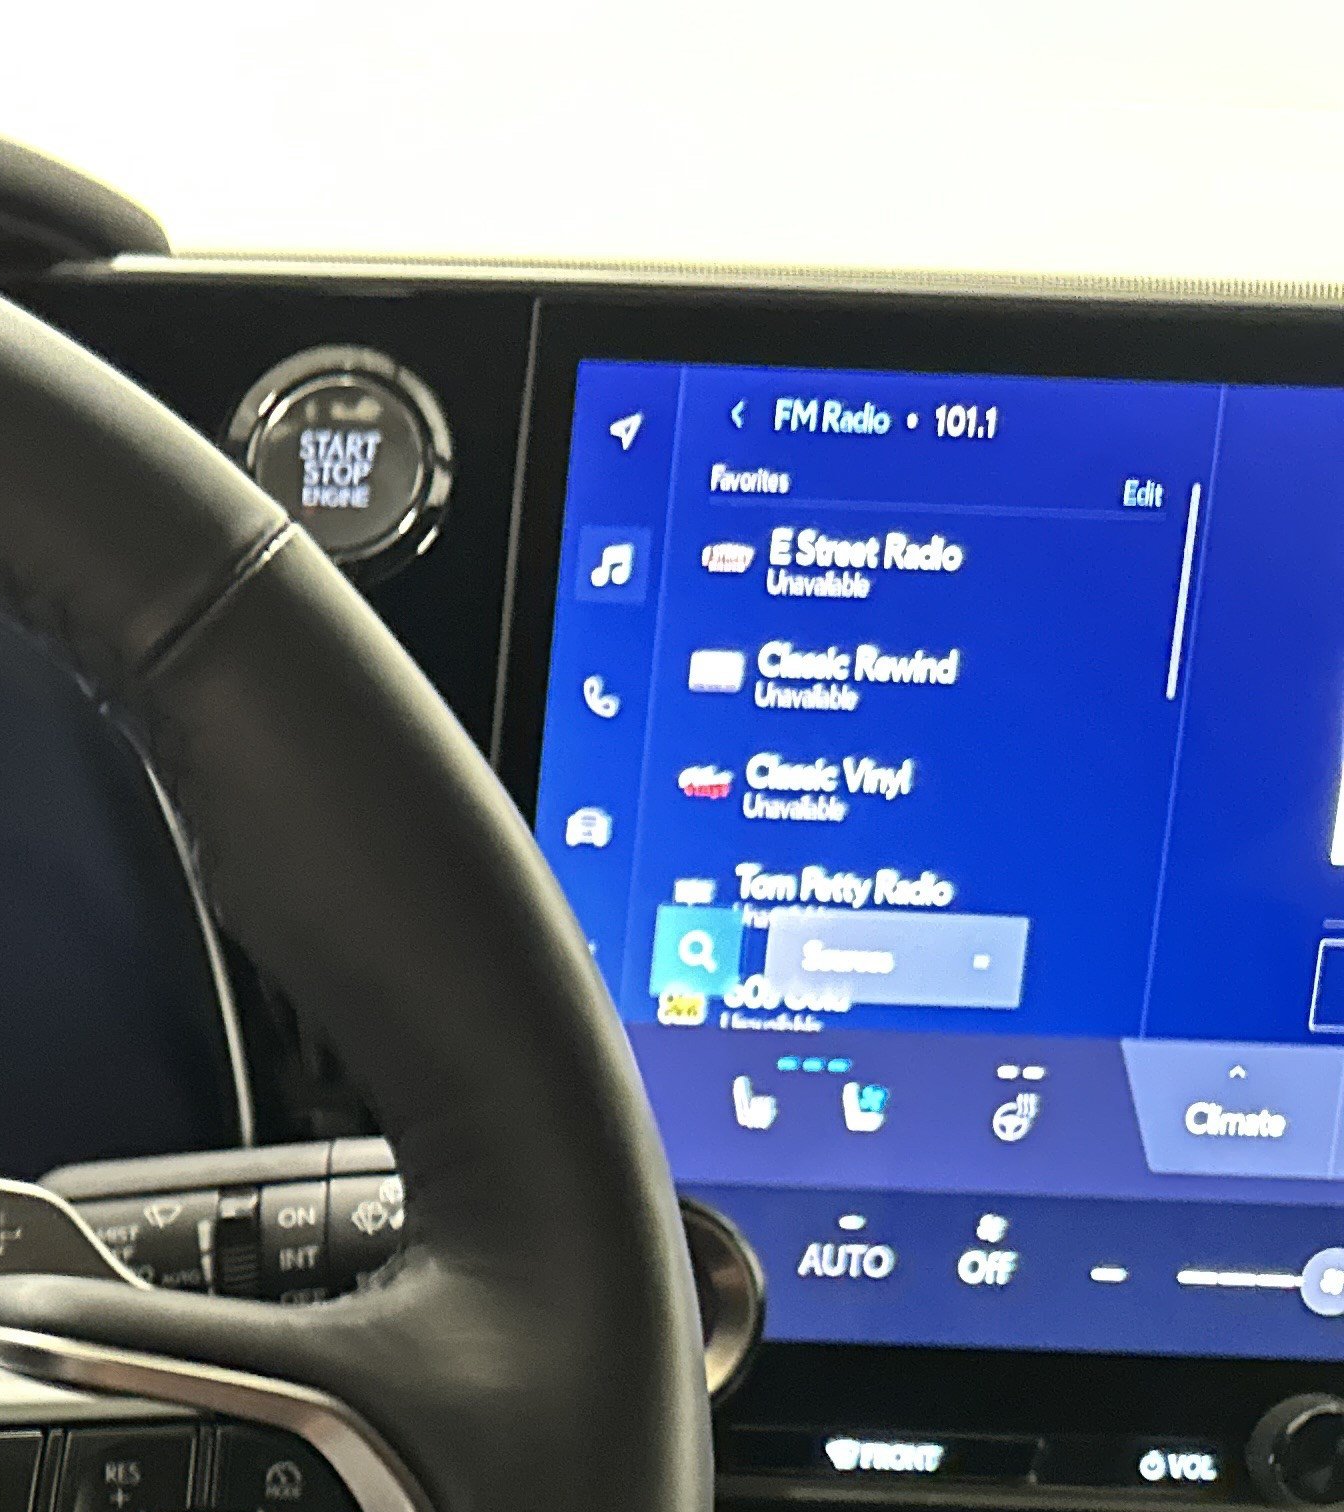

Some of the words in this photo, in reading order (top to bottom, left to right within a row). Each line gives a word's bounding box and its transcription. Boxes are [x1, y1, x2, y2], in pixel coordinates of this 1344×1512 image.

[774, 397, 817, 432] FM
[820, 399, 893, 435] Radio
[934, 404, 999, 439] 101.1
[299, 428, 382, 464] START
[302, 461, 374, 487] STOP
[709, 462, 791, 494] Favorites
[1122, 478, 1164, 510] Edit
[769, 526, 796, 567] E
[795, 527, 880, 570] Street
[882, 531, 965, 573] Radio
[765, 567, 872, 599] Unavailable
[756, 638, 852, 681] Classic
[853, 643, 962, 686] Rewind
[753, 680, 860, 712] Unavailable
[743, 751, 841, 793] Classic
[841, 755, 917, 802] Vinyl
[741, 791, 850, 824] Unavailable
[734, 861, 799, 901] Tom
[798, 864, 874, 909] Petty
[874, 867, 956, 907] Radio
[1184, 1101, 1288, 1139] Climate
[277, 1206, 317, 1229] ON
[278, 1245, 319, 1272] INT
[797, 1242, 898, 1281] AUTO
[957, 1248, 1019, 1287] Off
[105, 1462, 142, 1485] RES
[1168, 1451, 1218, 1481] VOL
